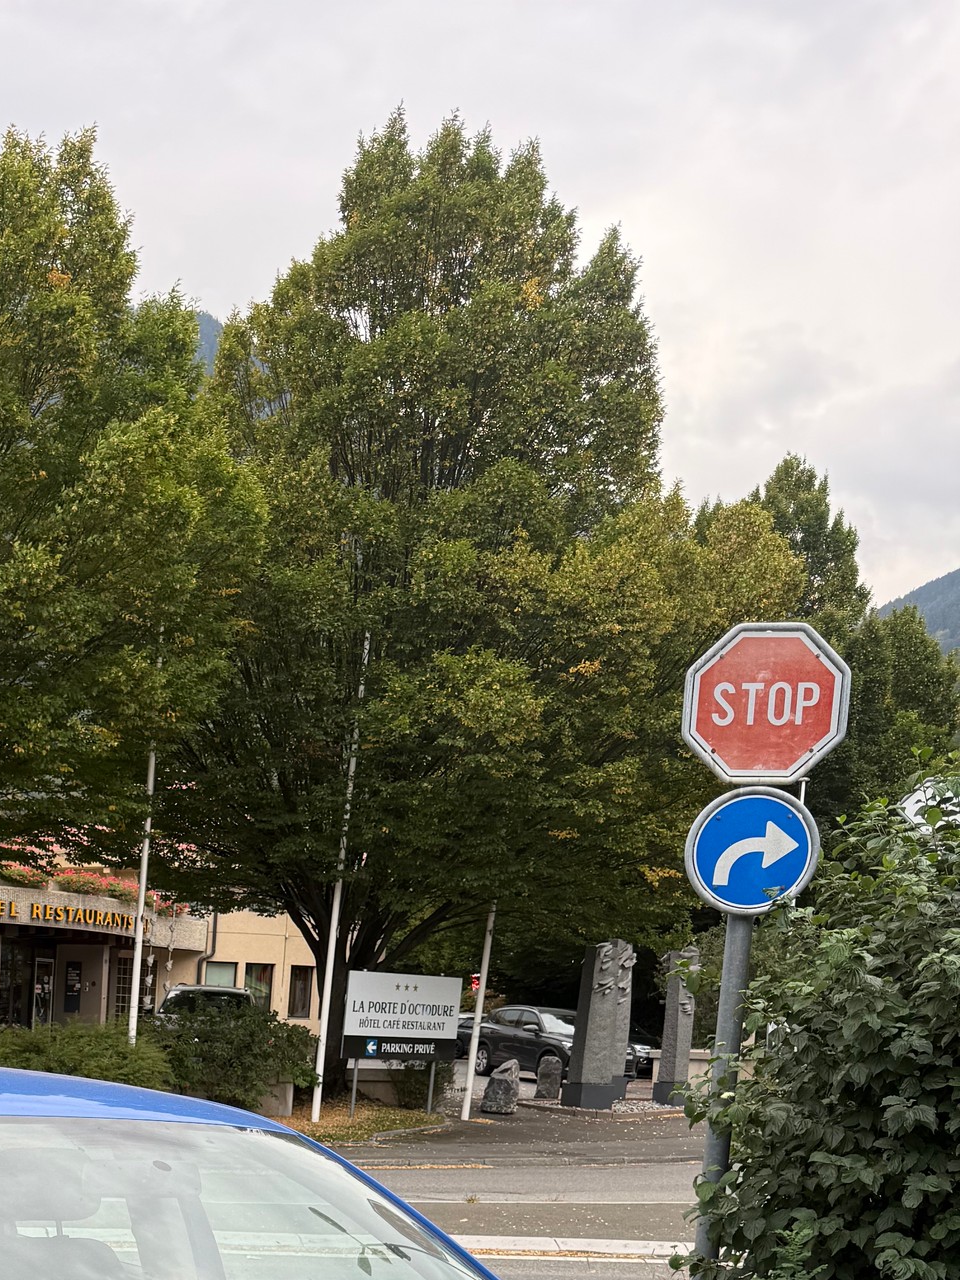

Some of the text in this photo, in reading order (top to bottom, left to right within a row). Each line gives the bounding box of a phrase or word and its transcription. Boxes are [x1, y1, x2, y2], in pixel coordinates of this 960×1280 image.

[711, 681, 821, 727] STOP
[352, 1000, 364, 1013] LA
[367, 1001, 398, 1015] PORTE
[358, 1017, 445, 1031] HÔTEL CAFÉ RESTAURANT
[381, 1042, 435, 1054] PARKING PRIVÉ
